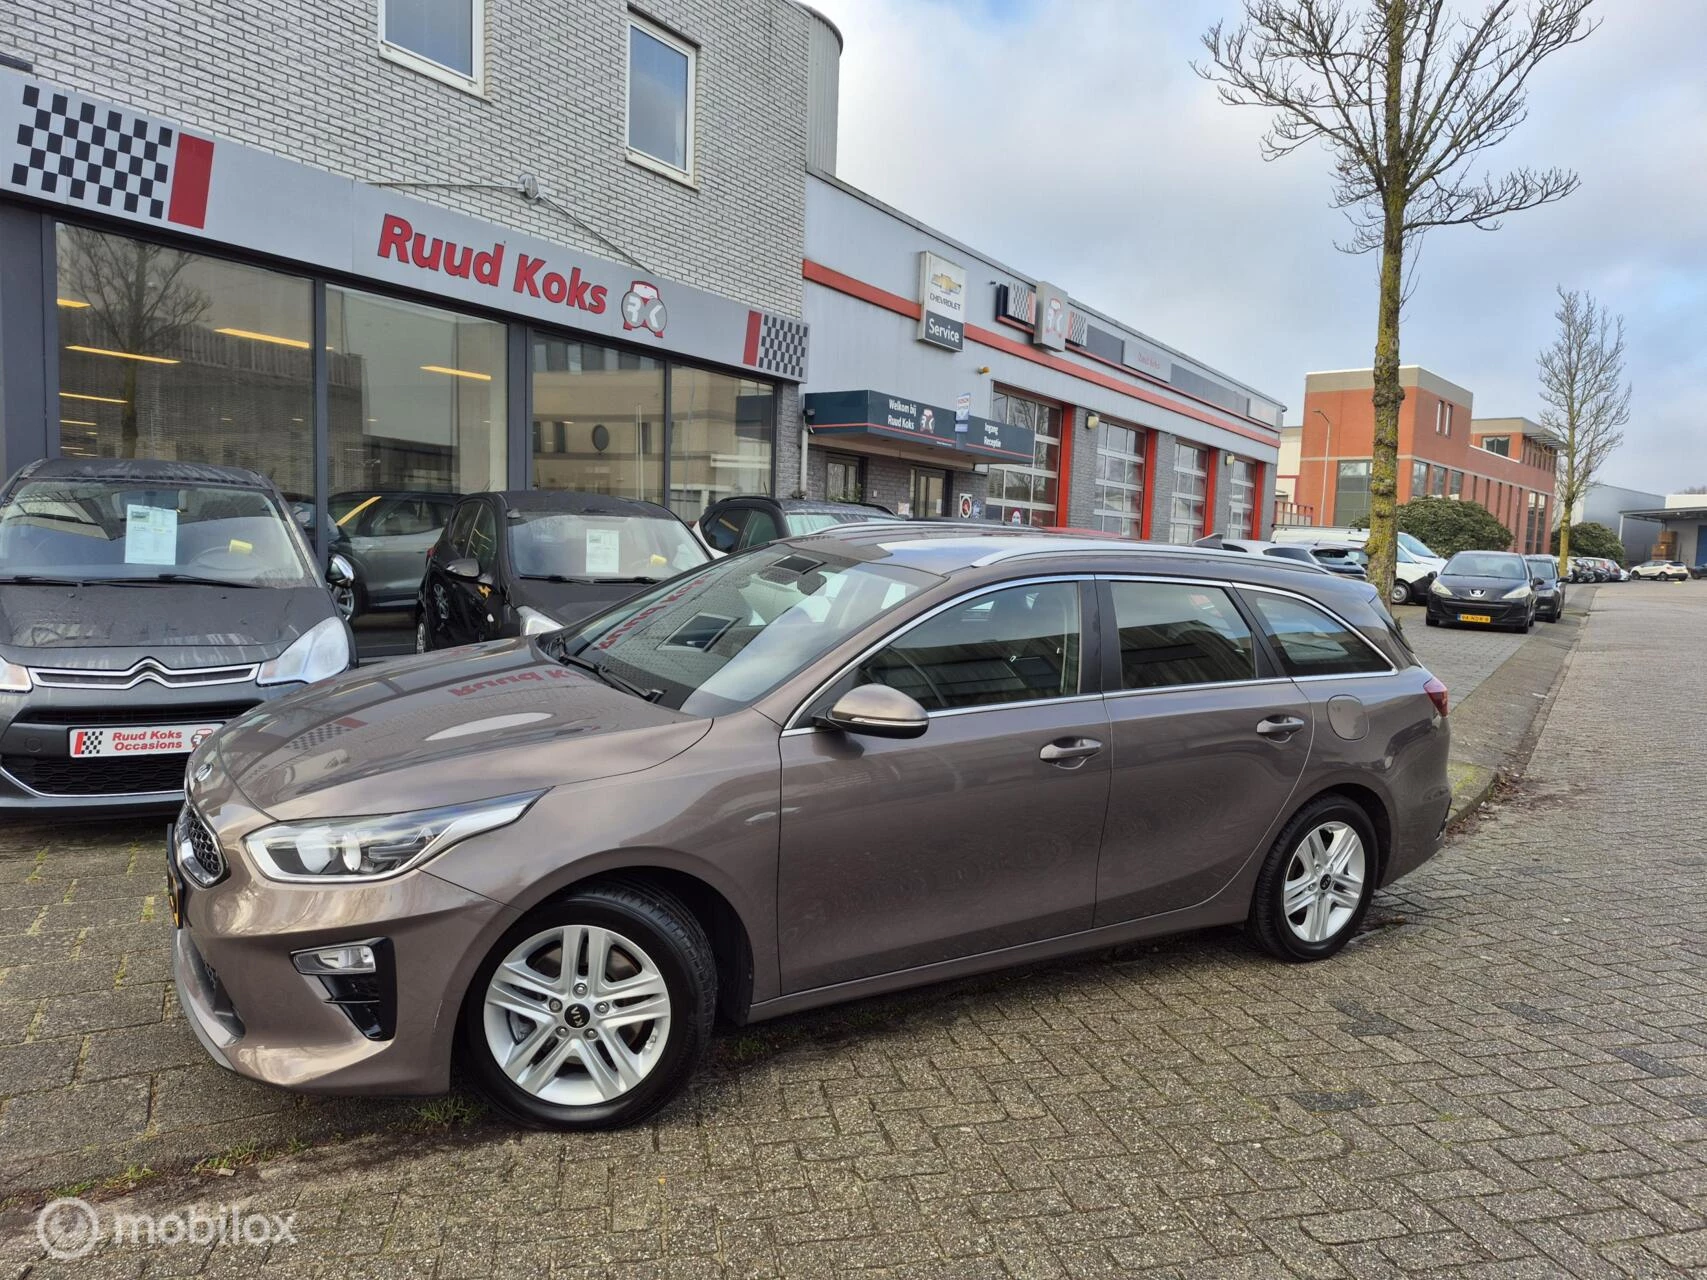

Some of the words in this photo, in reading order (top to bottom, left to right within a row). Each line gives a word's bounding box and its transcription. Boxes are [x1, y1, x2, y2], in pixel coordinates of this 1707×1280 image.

[377, 213, 505, 287] Ruud
[513, 253, 608, 314] Koks
[929, 292, 961, 311] CHEVROLET
[929, 318, 960, 343] Service
[888, 399, 909, 414] Welkom
[887, 415, 902, 427] Ruud
[902, 417, 915, 430] Koks
[112, 731, 147, 741] Ruud
[150, 730, 182, 740] Koks
[114, 740, 182, 751] Occasions
